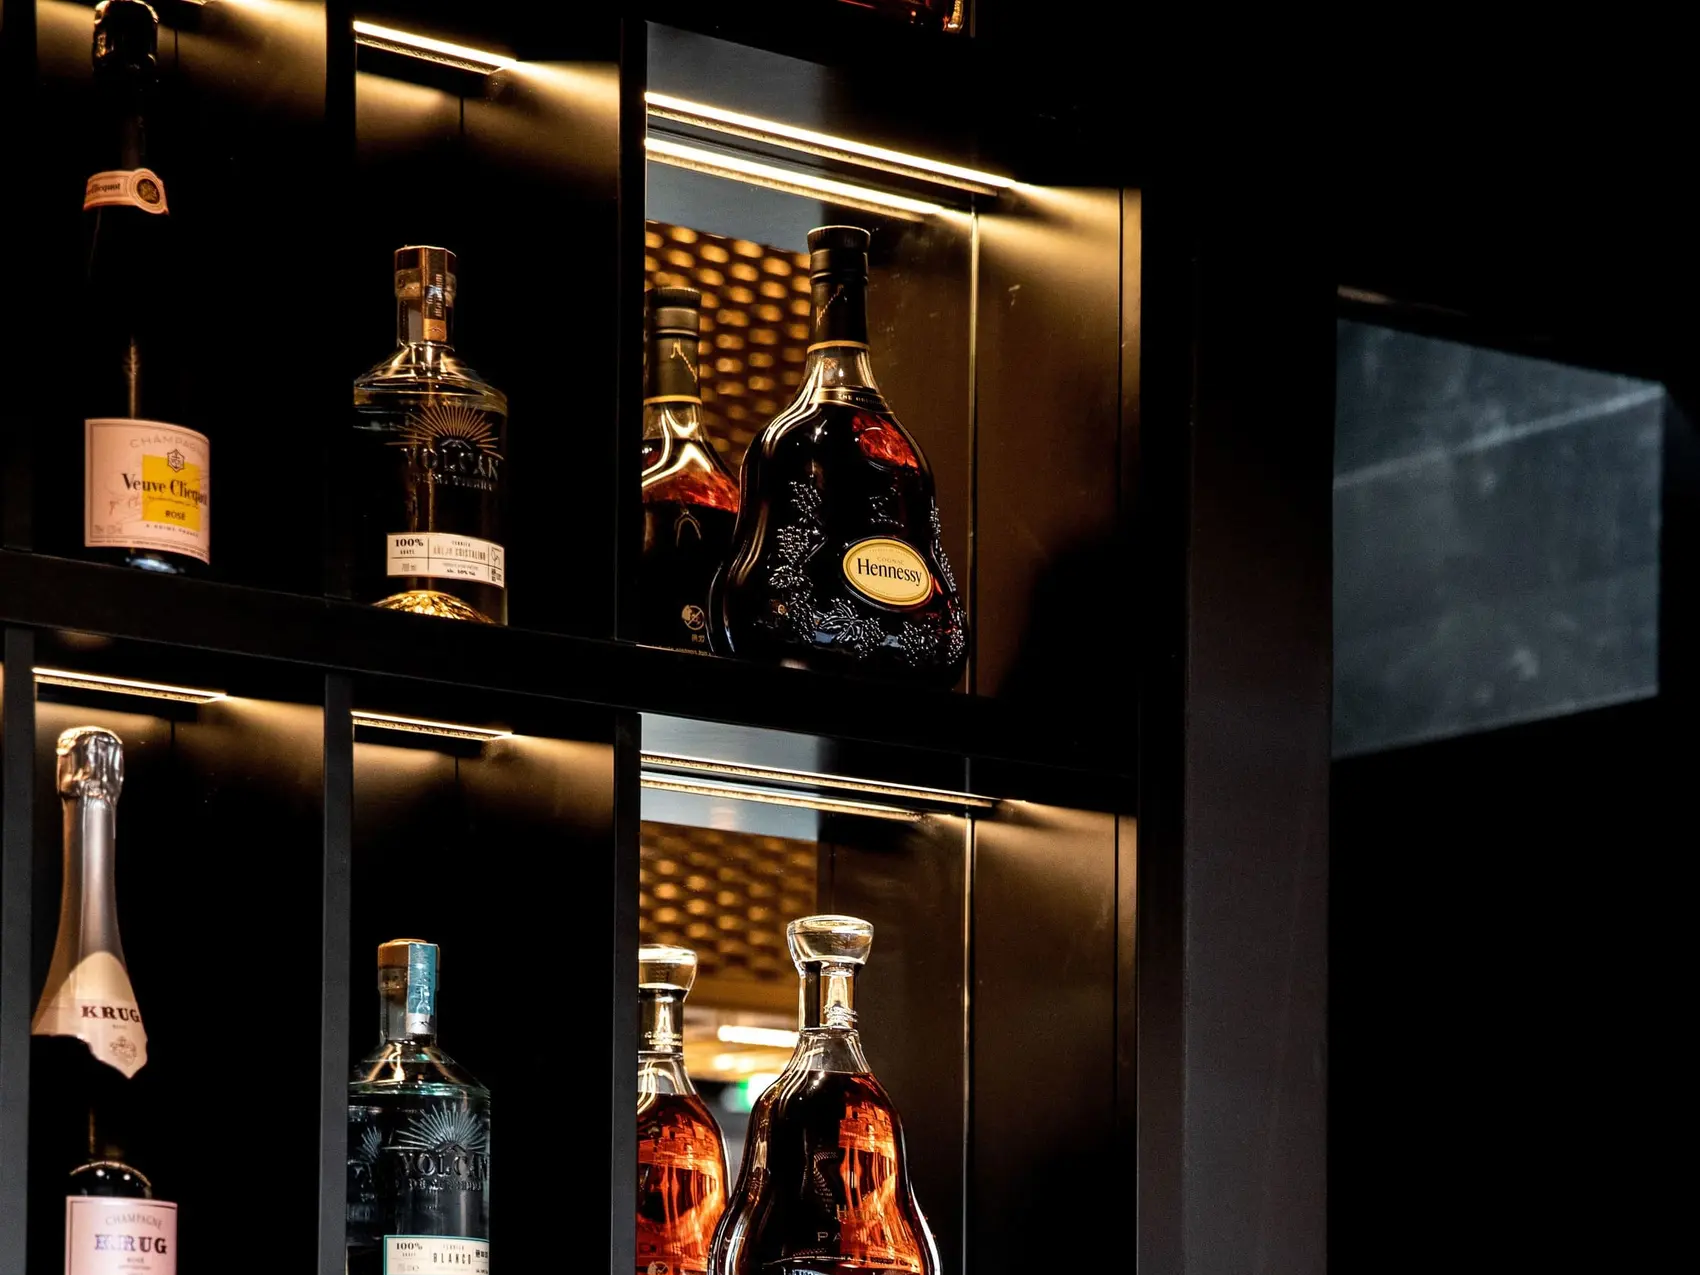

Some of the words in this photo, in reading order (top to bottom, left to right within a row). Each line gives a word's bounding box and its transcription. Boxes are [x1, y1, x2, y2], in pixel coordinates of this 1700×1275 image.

[121, 473, 167, 493] Veuve
[395, 538, 424, 547] 100%
[857, 558, 922, 587] Hennessy
[81, 1004, 141, 1023] KRUG
[105, 1213, 164, 1230] CHAMPAGNE
[396, 1242, 423, 1250] 100%
[433, 1252, 472, 1265] BLANCO
